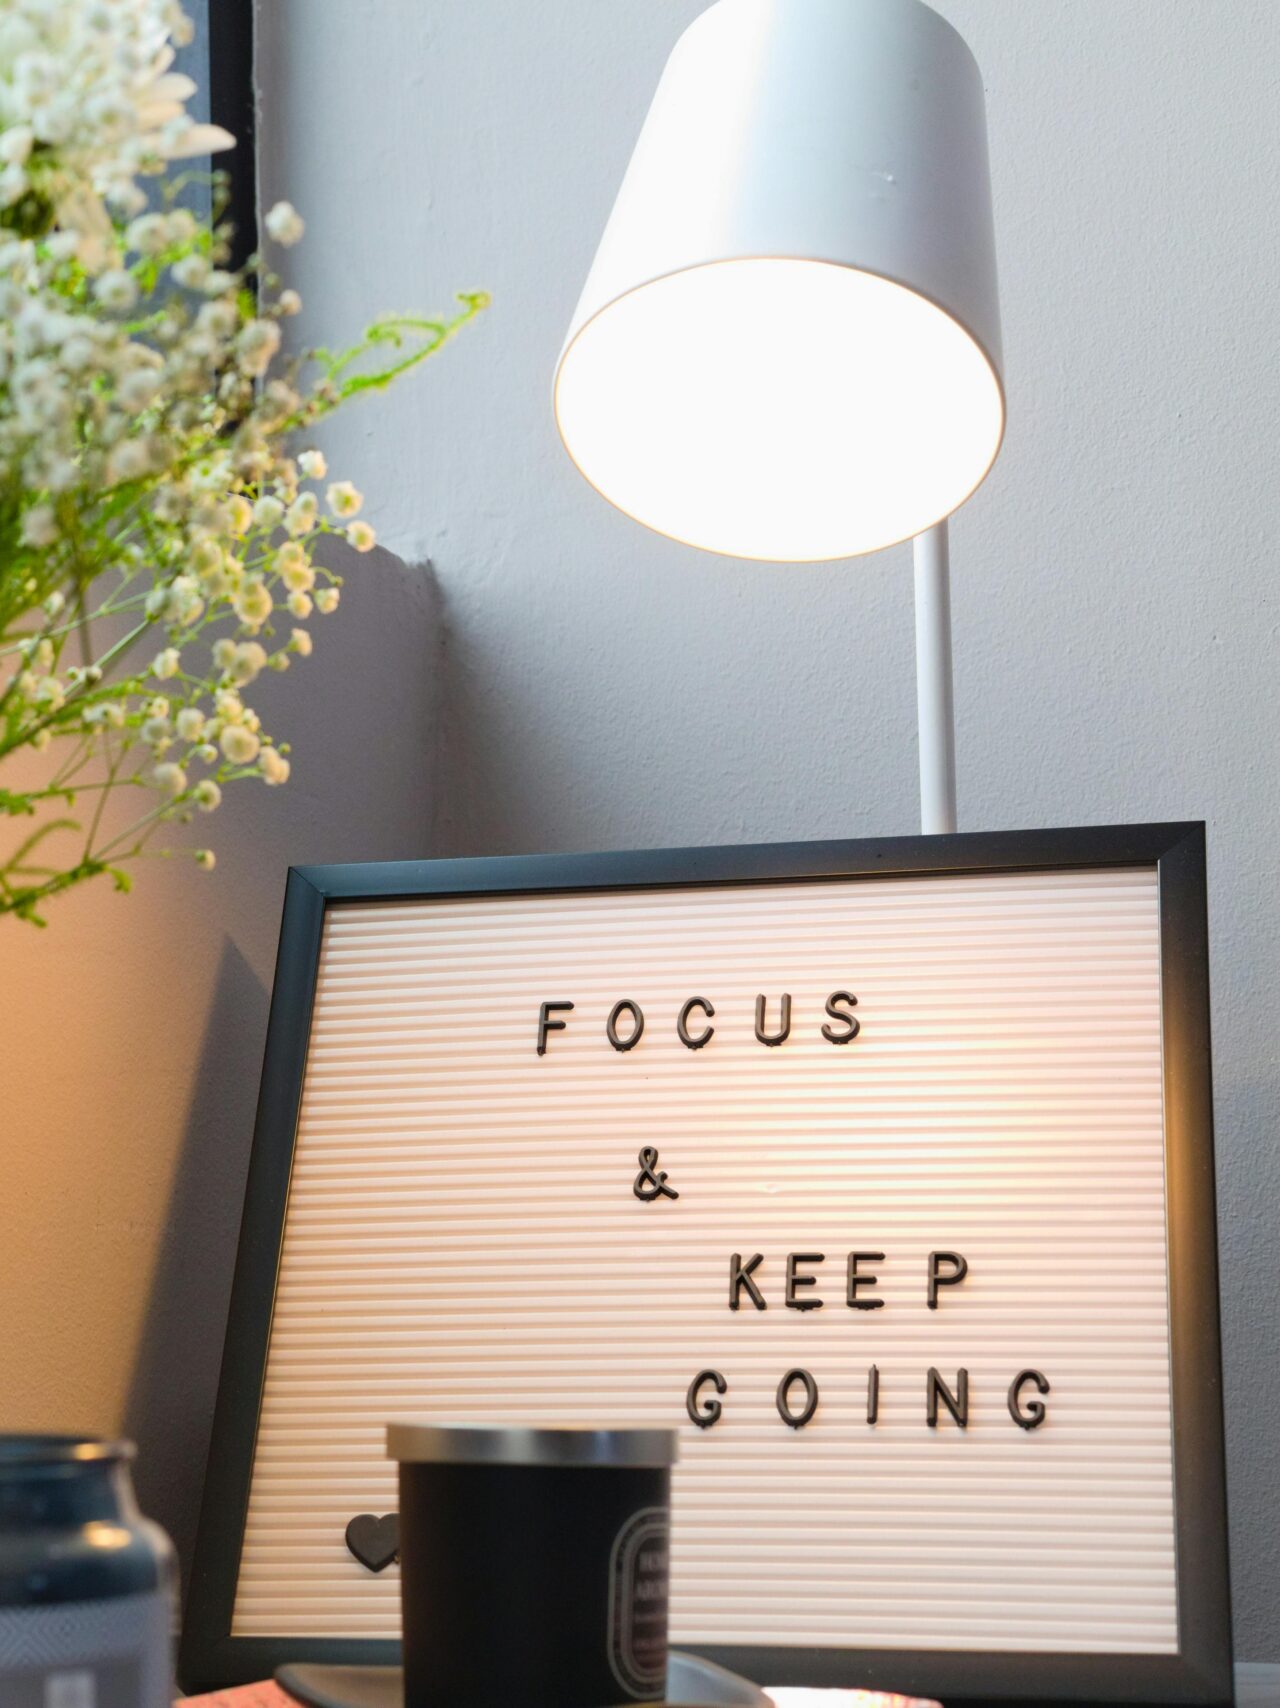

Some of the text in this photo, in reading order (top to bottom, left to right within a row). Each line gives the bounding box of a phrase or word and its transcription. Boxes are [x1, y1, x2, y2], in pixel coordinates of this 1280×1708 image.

[536, 990, 861, 1056] FOCUS
[633, 1145, 679, 1202] &
[728, 1250, 968, 1311] KEEP
[686, 1363, 1051, 1430] GOING
